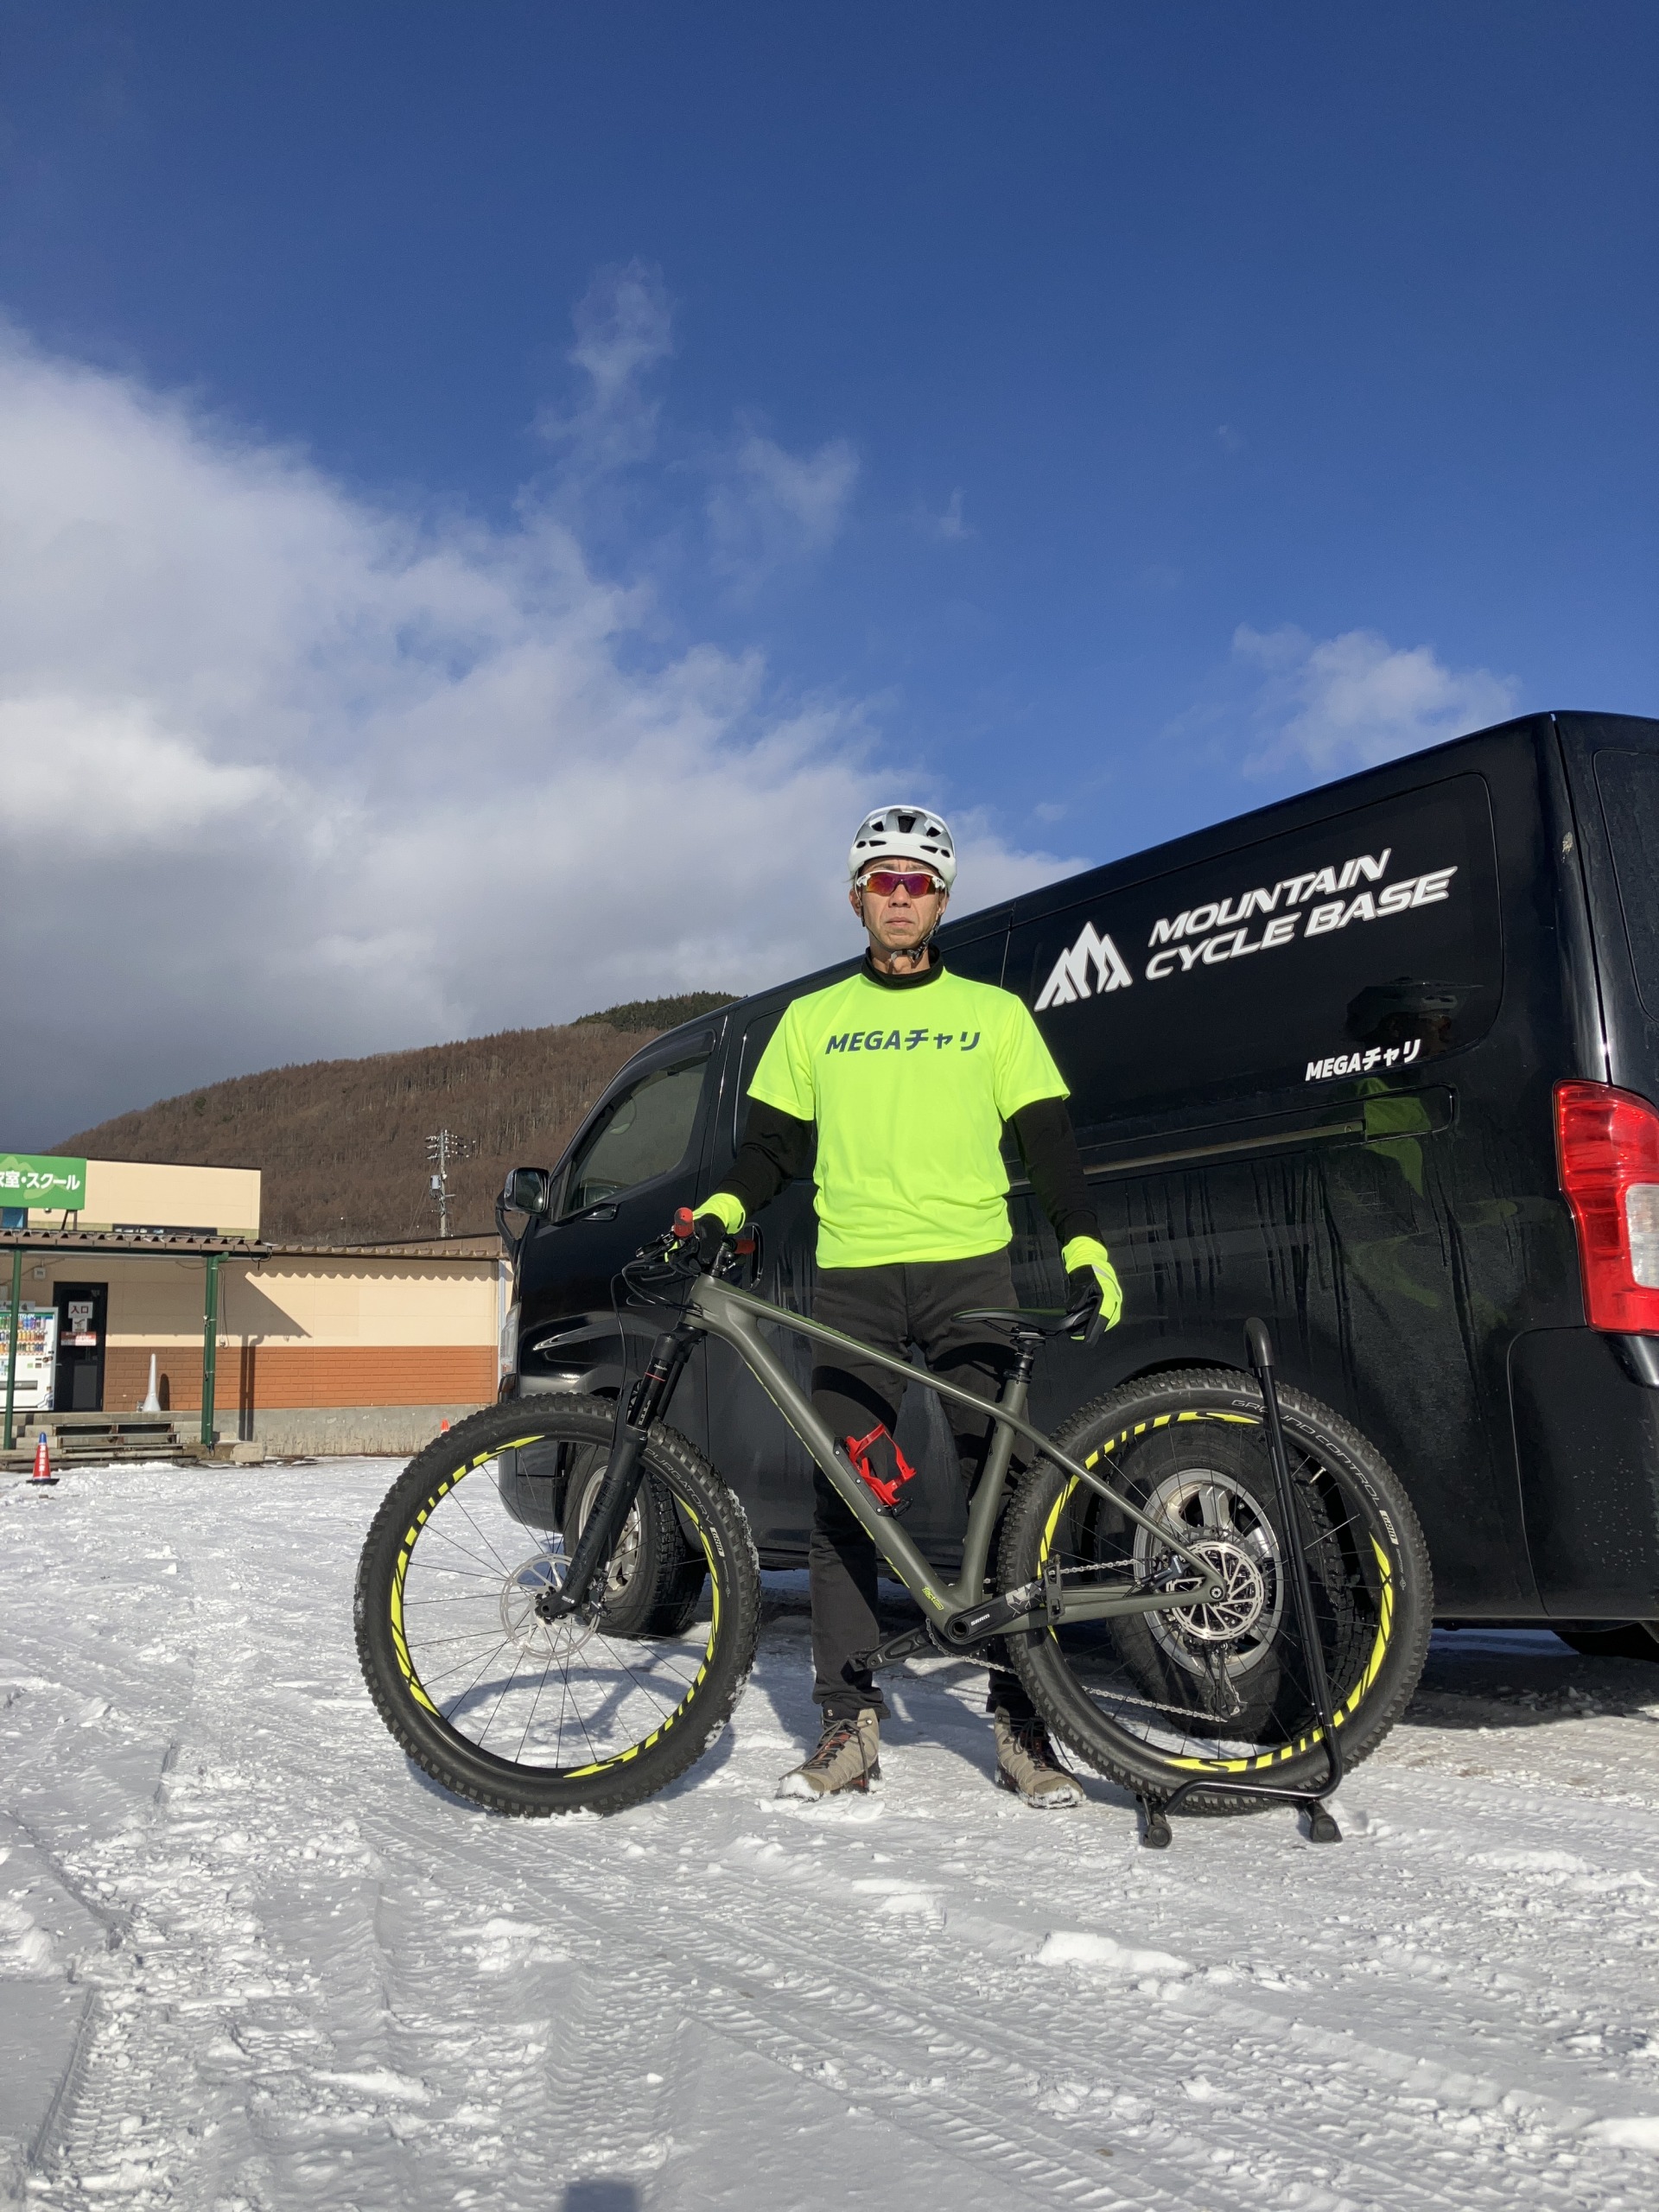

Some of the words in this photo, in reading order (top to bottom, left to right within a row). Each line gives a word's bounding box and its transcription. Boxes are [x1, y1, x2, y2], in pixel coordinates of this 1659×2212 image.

[1145, 912, 1301, 980] CYCLE
[1304, 866, 1458, 938] BASE
[1147, 848, 1392, 947] MOUNTAIN
[824, 1028, 981, 1055] MEGAチャリ
[1305, 1039, 1421, 1082] MEGAチャリ
[71, 1305, 89, 1314] 入口
[644, 1447, 713, 1525] PURGATORY
[1315, 1434, 1380, 1507] CONTROL
